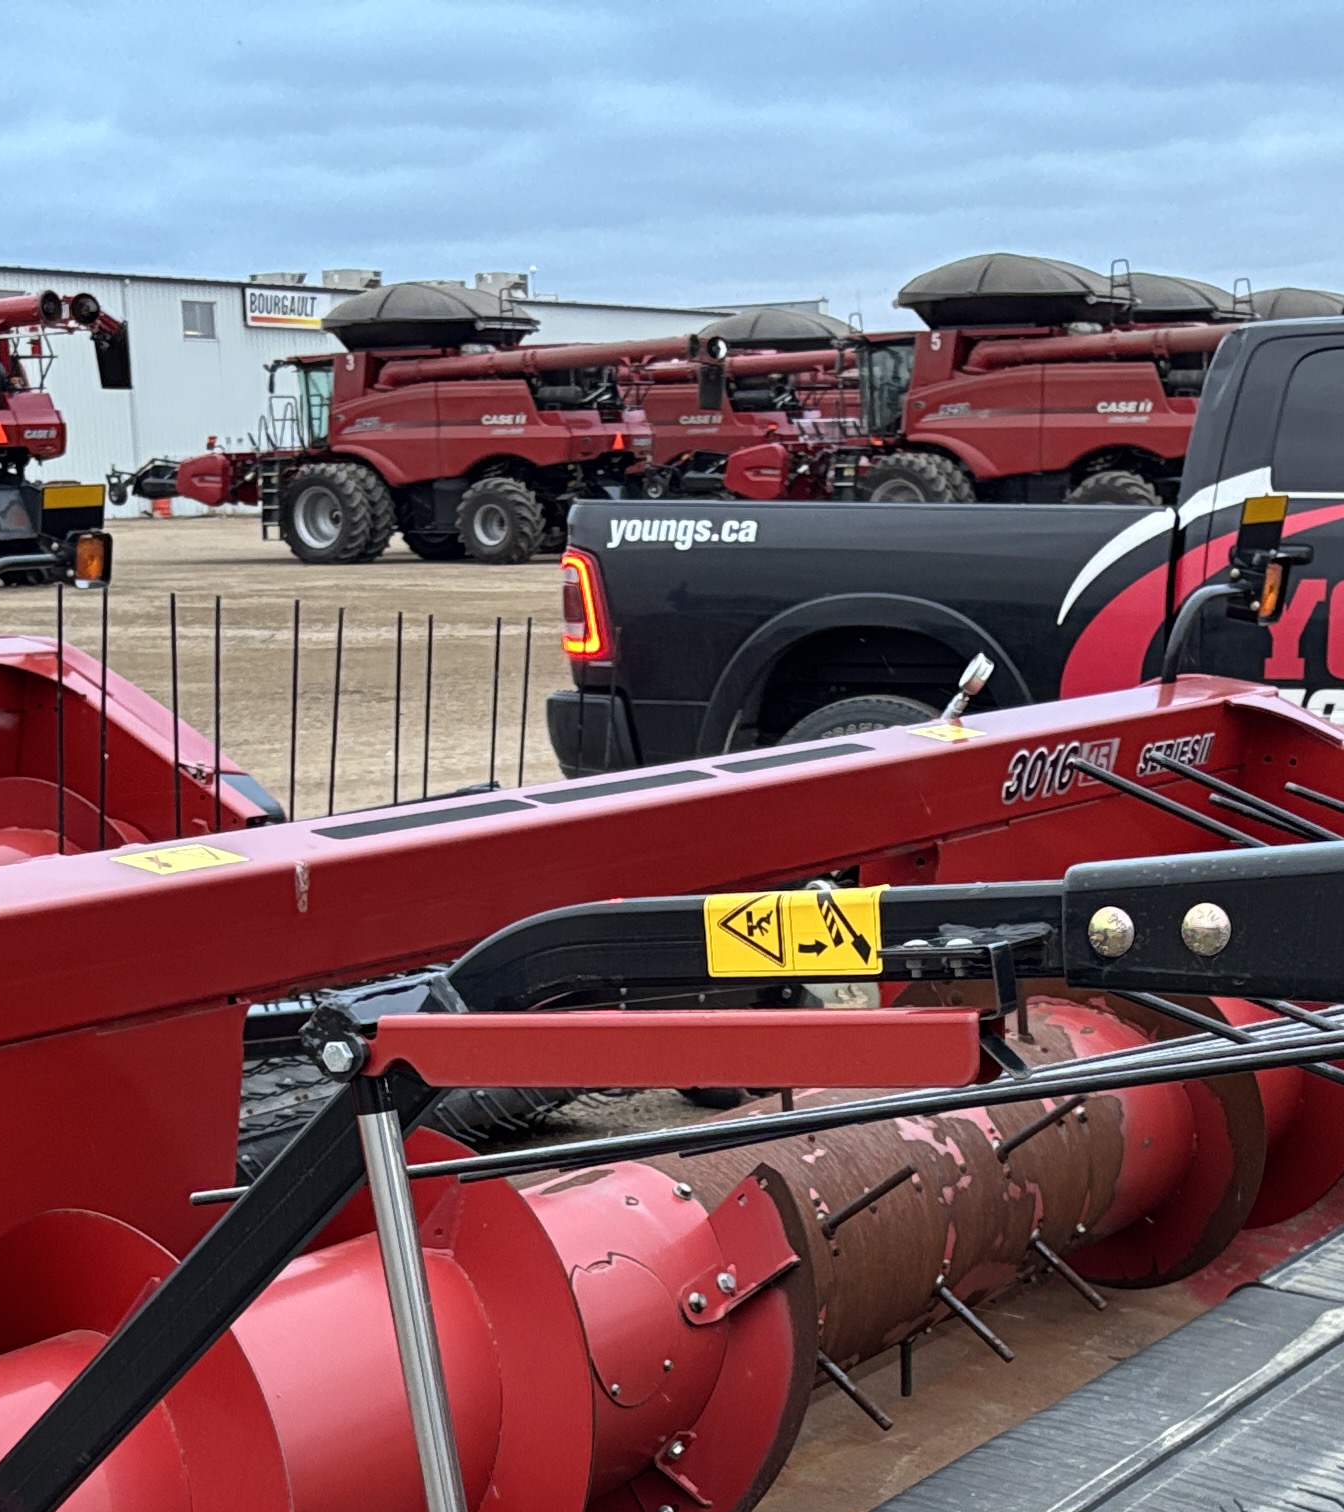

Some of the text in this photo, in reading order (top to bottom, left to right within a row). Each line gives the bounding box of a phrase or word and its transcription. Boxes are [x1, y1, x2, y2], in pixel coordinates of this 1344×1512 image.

[249, 292, 318, 317] BOURGAULT
[931, 333, 942, 351] 5
[345, 354, 355, 371] 3
[1096, 401, 1137, 413] CASE
[481, 414, 514, 425] CASE
[606, 518, 759, 551] youngs.ca
[1001, 741, 1081, 805] 3016
